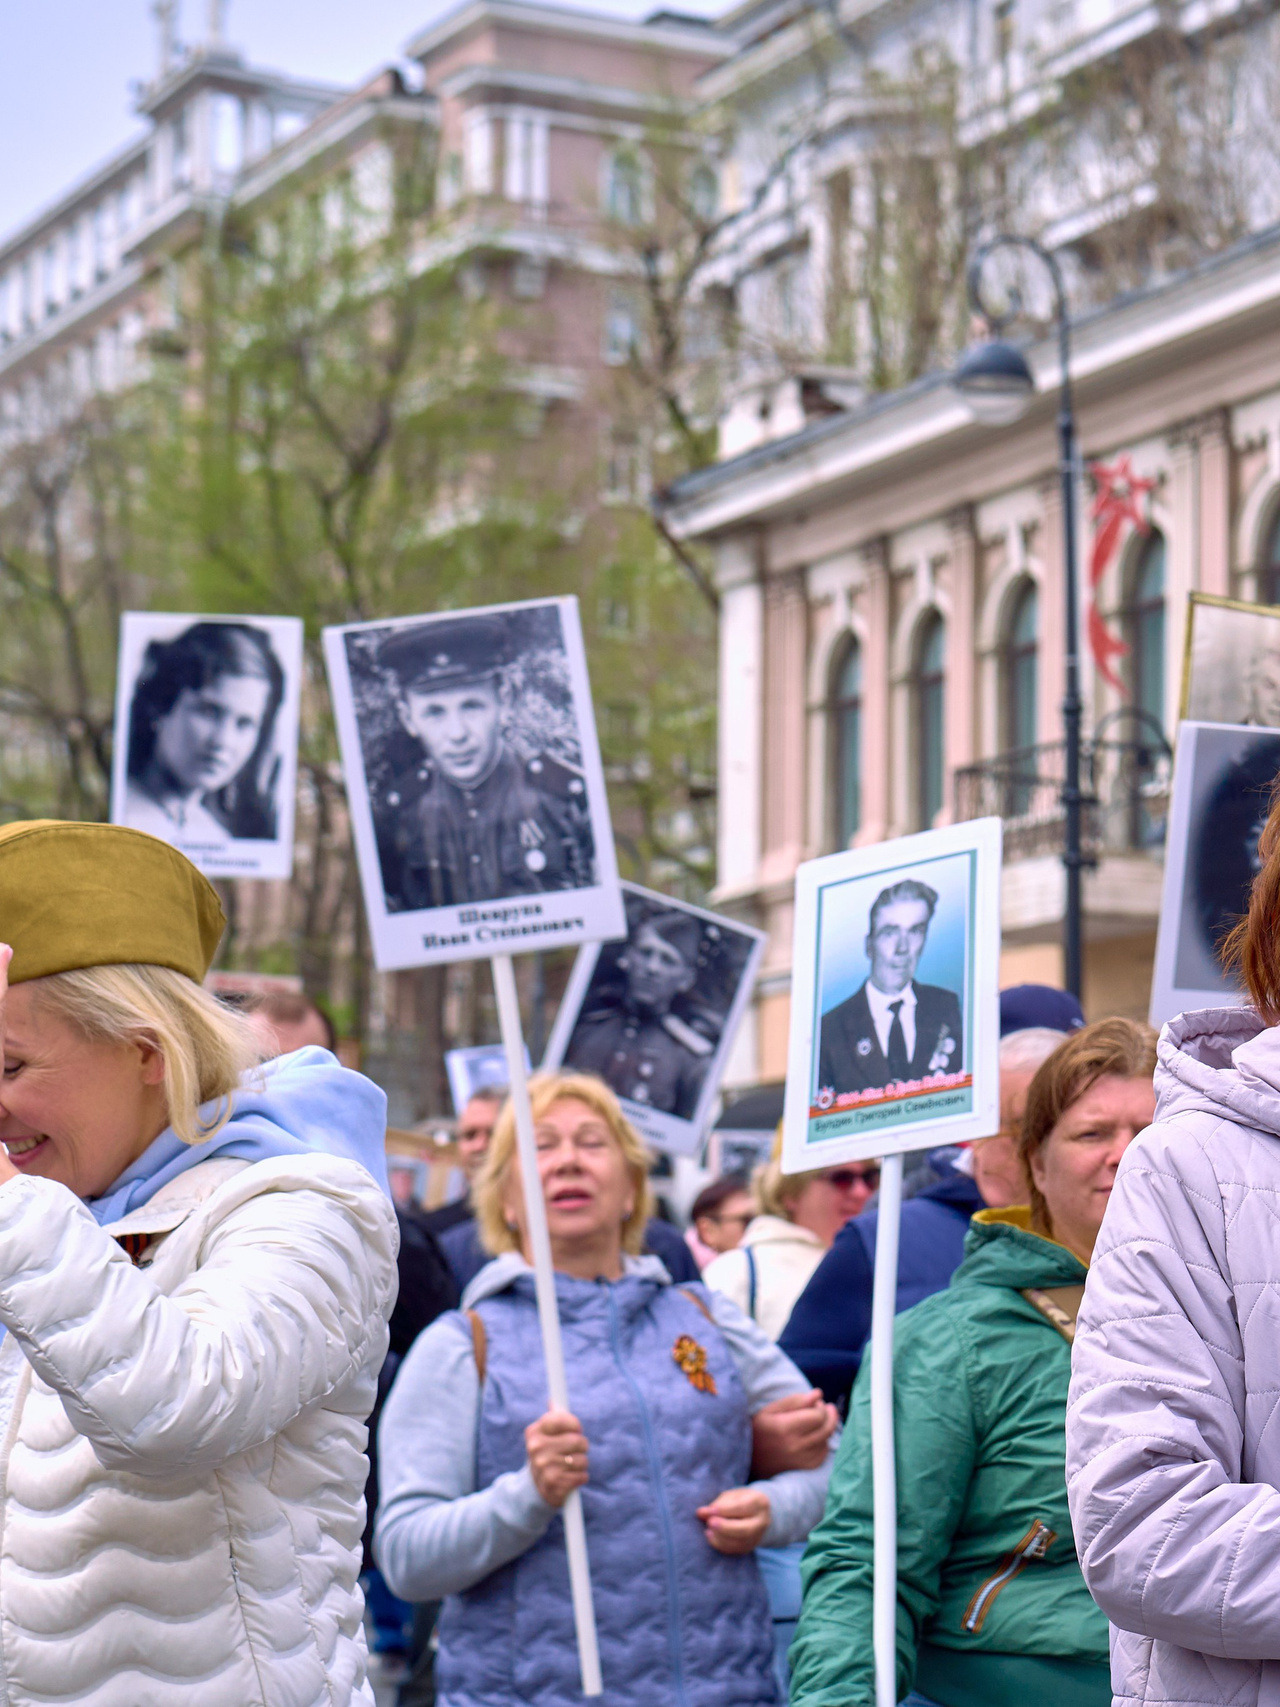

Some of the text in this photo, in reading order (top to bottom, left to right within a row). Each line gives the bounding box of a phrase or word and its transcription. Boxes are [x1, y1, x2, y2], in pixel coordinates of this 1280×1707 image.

[422, 917, 584, 949] Иван Степанович
[854, 1105, 903, 1125] Григорий
